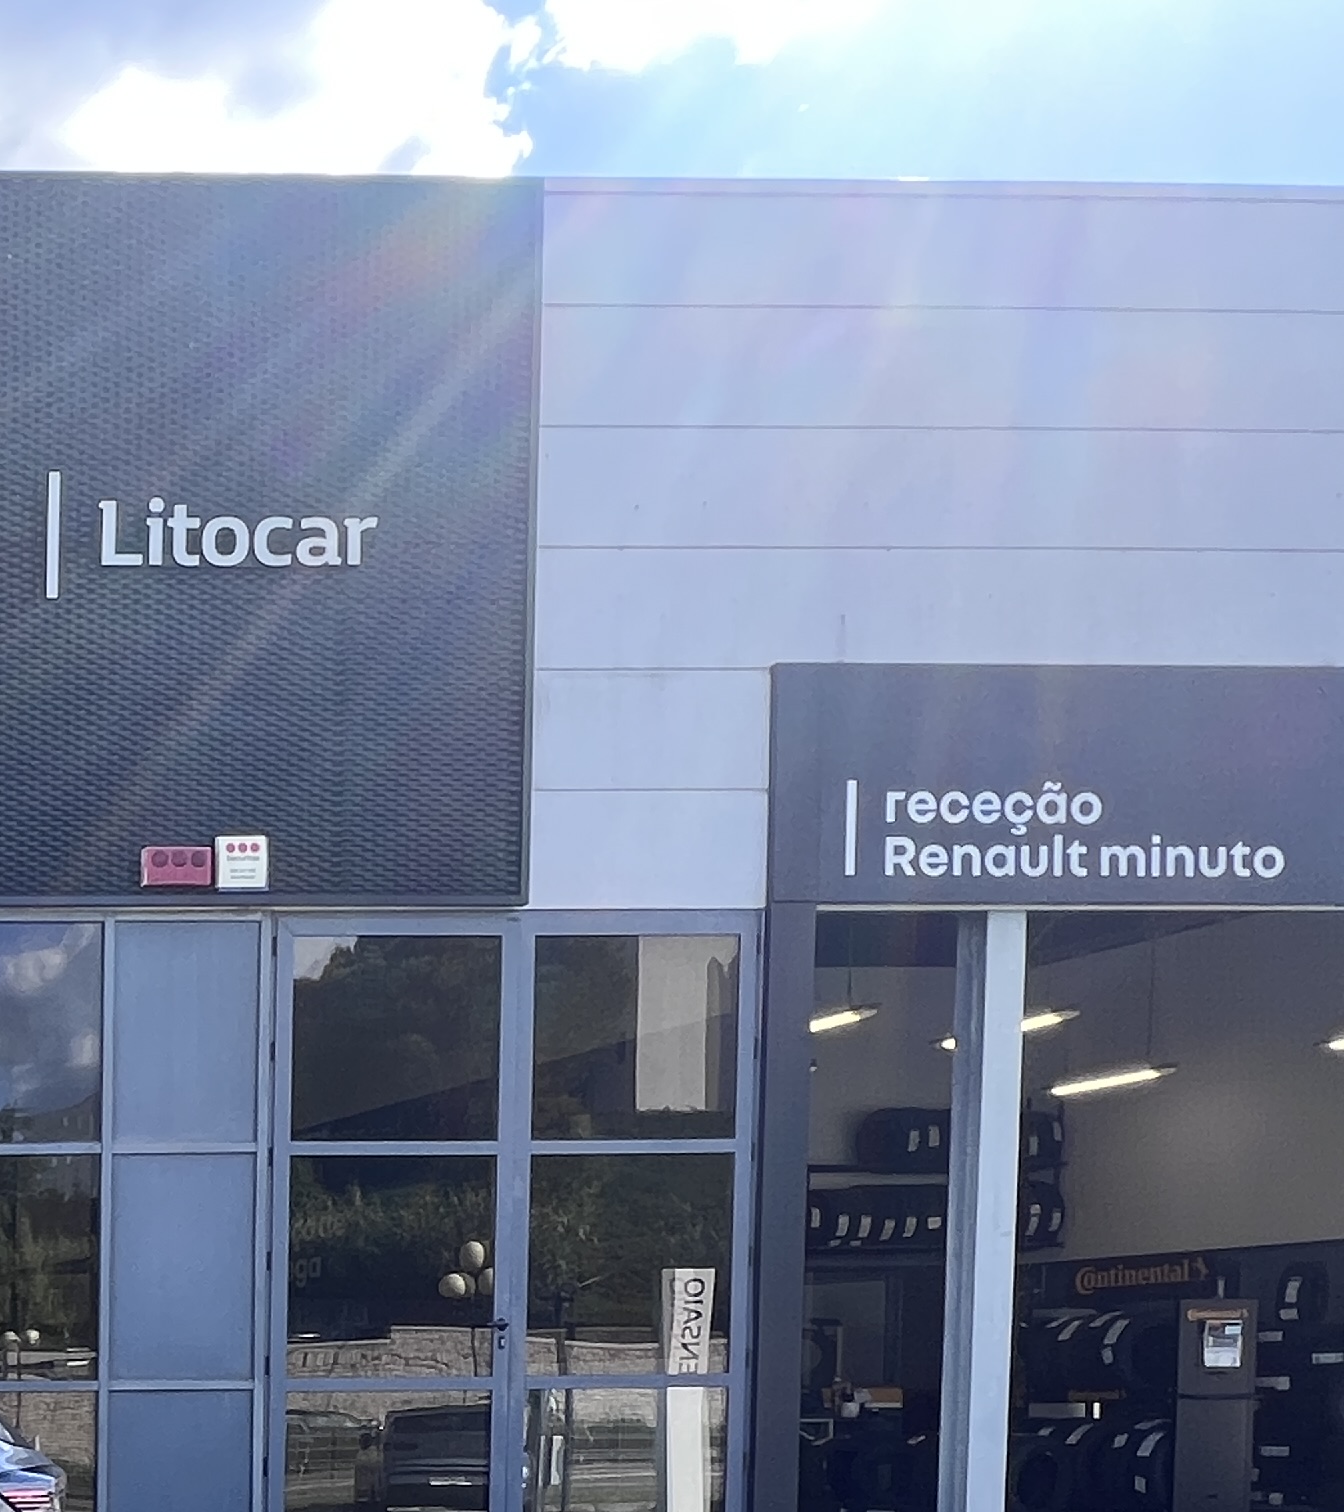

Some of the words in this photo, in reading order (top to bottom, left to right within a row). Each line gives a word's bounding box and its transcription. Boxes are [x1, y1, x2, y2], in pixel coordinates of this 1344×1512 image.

[98, 497, 379, 567] Litocar
[884, 780, 1103, 836] receção
[884, 835, 1089, 878] Renault
[1099, 835, 1286, 878] minuto
[1075, 1259, 1190, 1294] Continental
